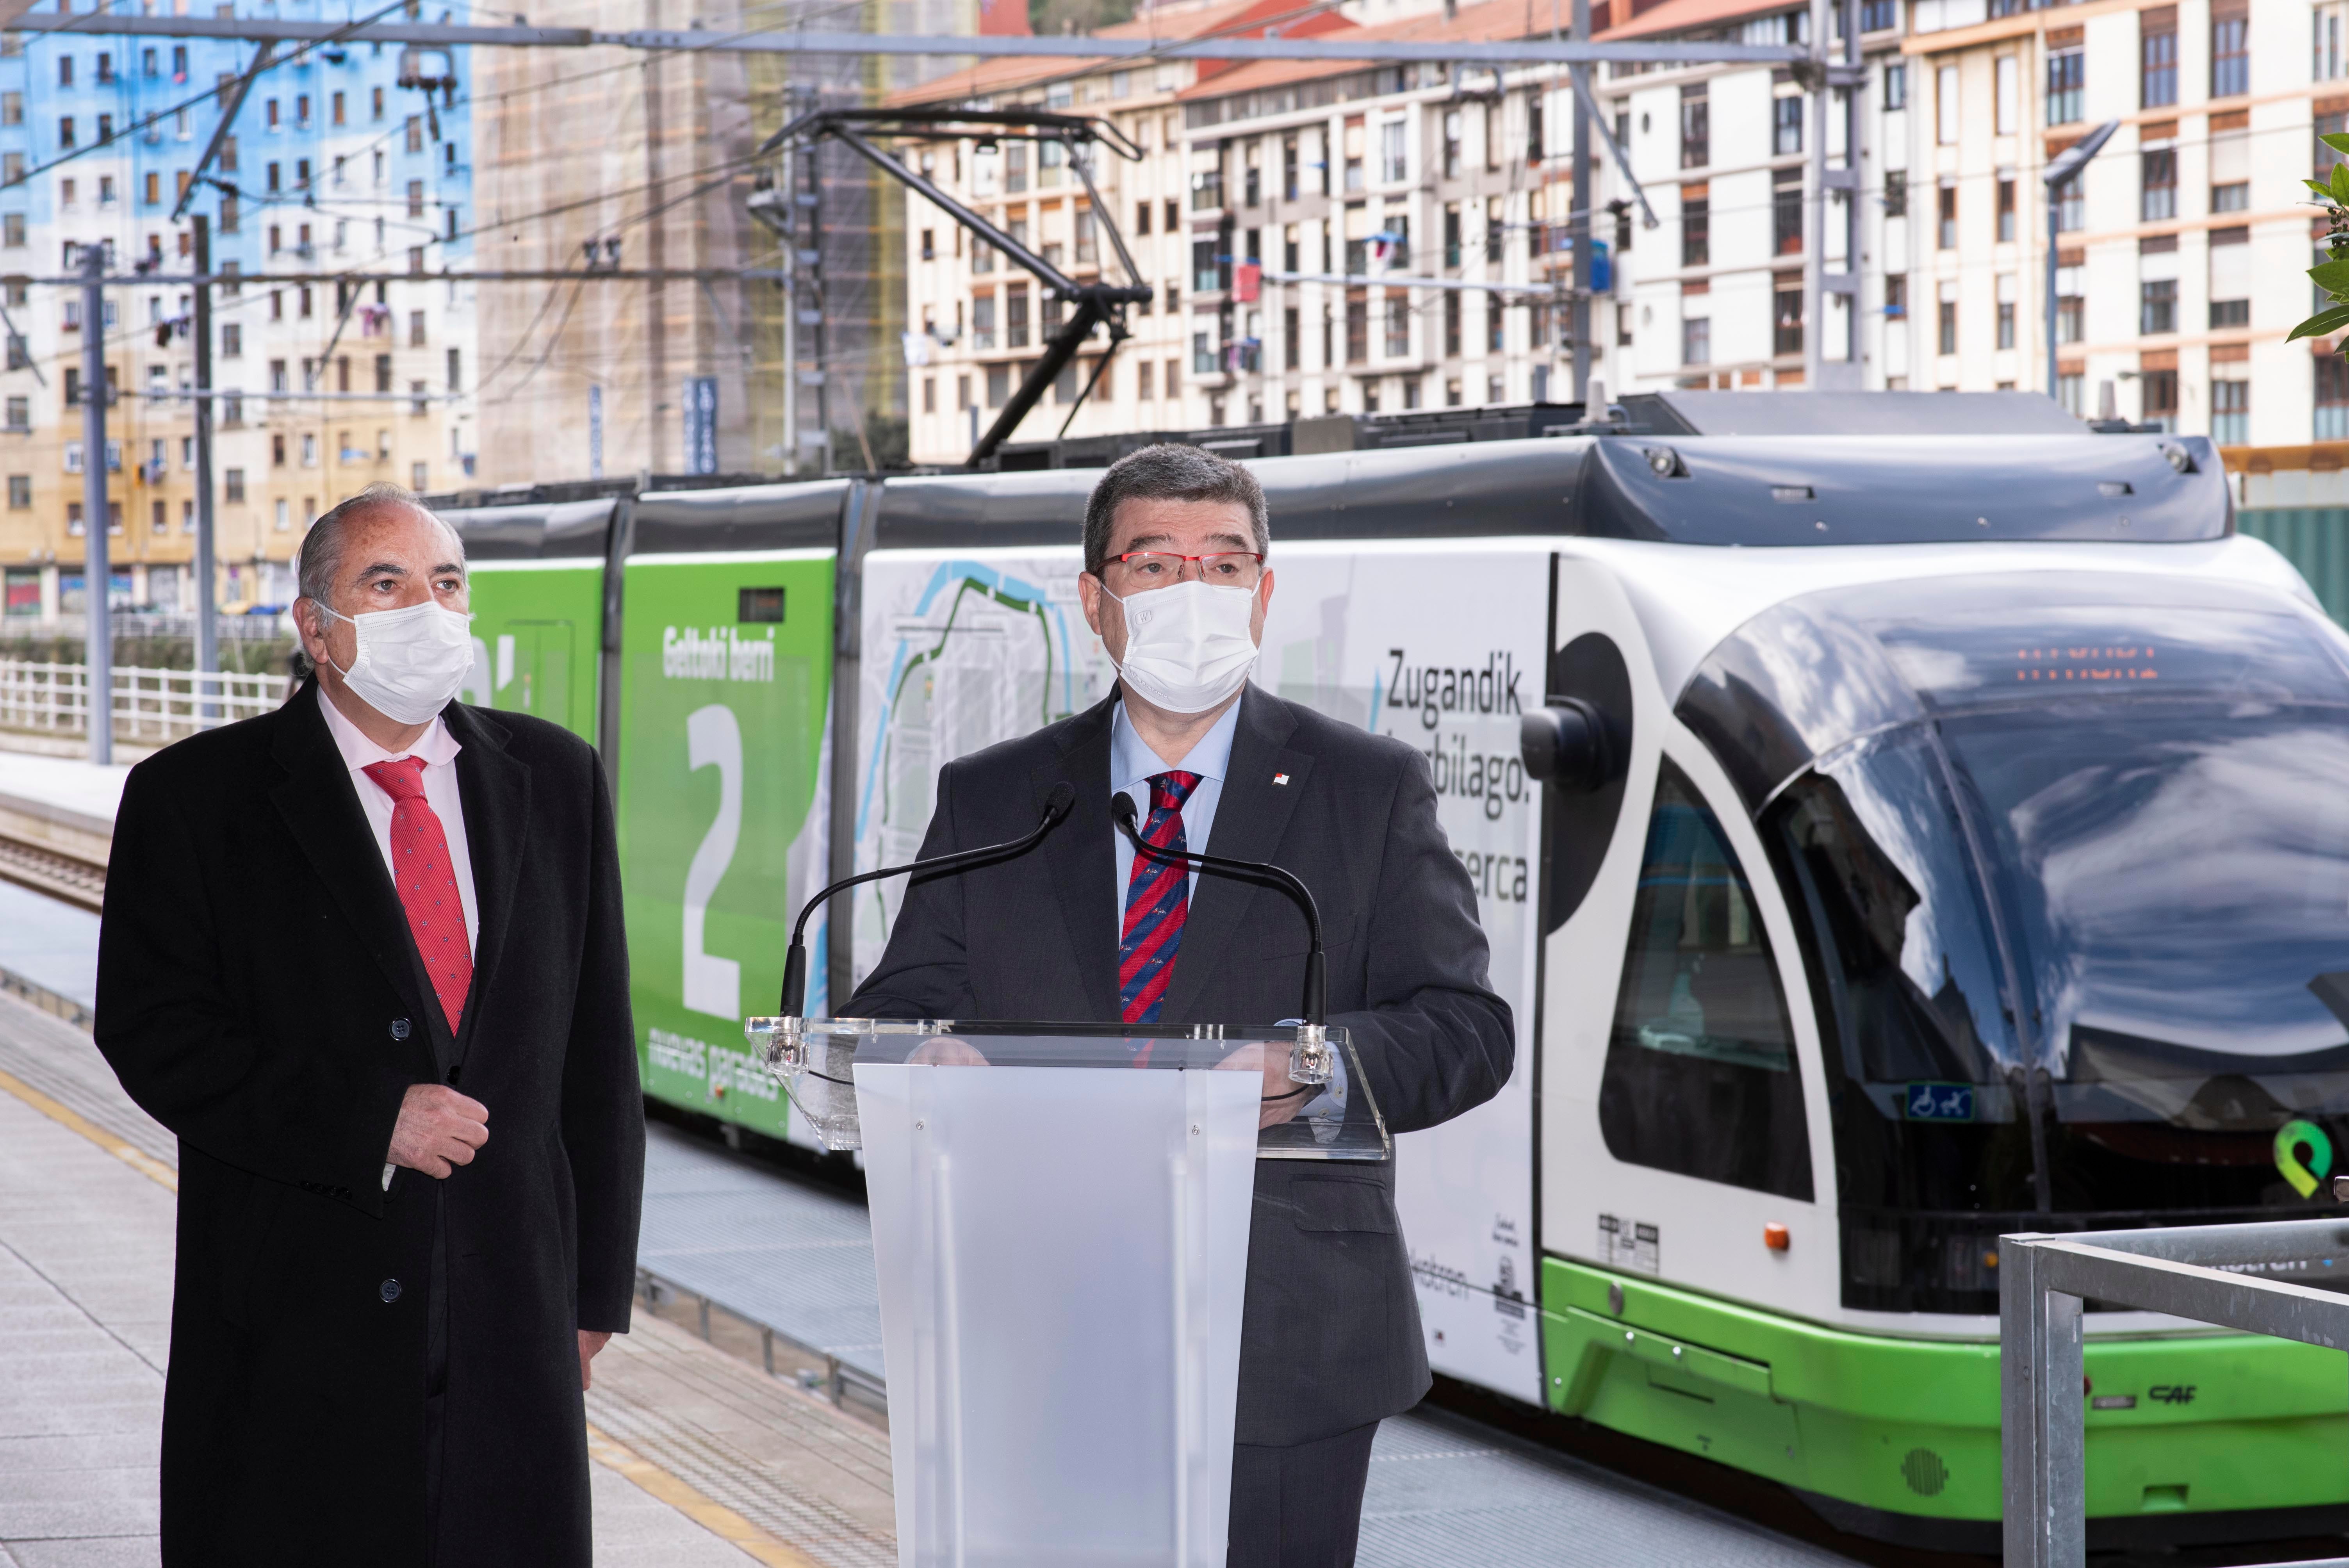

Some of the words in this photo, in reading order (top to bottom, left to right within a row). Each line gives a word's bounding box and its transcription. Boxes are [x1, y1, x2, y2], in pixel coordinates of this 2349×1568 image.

[1388, 649, 1522, 730] Zugandik
[1387, 728, 1530, 821] bilago.
[682, 704, 743, 1020] 2
[1453, 848, 1527, 903] erca
[2149, 1385, 2197, 1405] CAF
